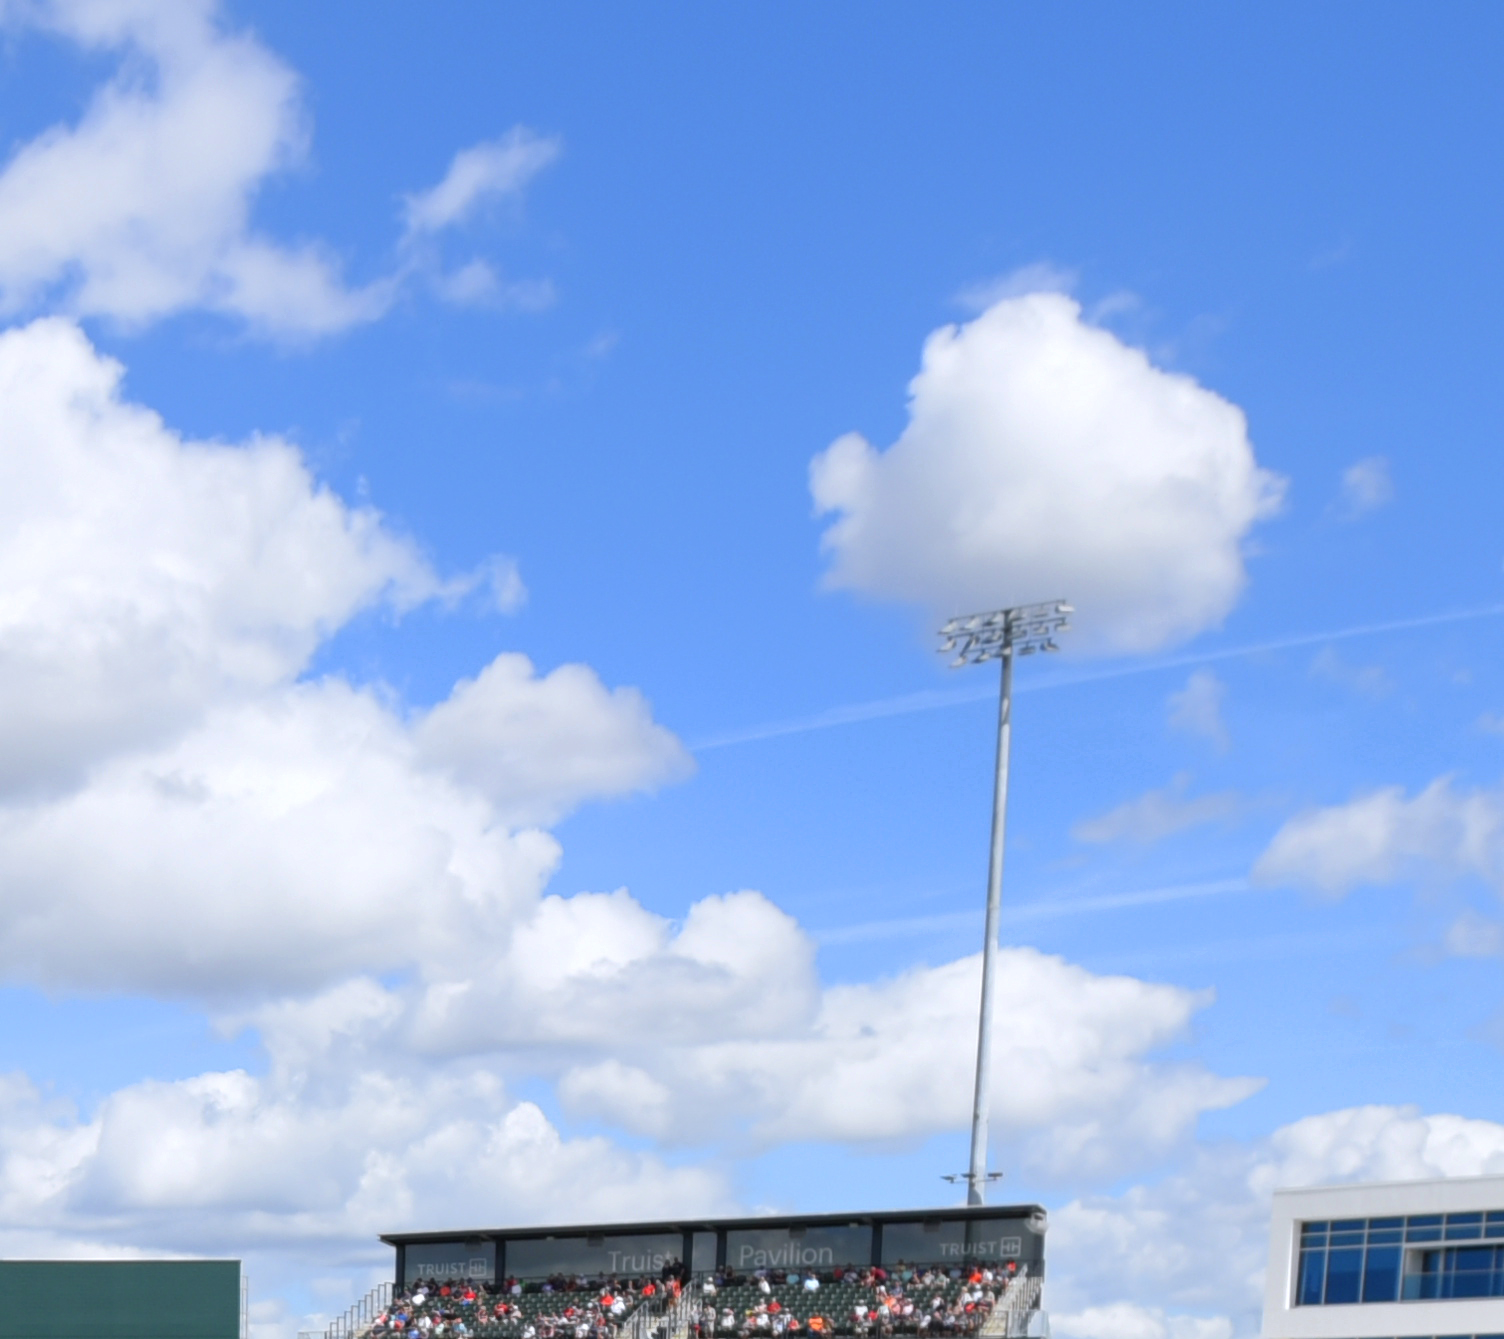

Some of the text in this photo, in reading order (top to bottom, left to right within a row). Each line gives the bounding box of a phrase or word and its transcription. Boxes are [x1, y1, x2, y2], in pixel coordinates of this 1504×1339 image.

[940, 1241, 998, 1257] TRUIST
[607, 1244, 834, 1273] Truist Pavilion
[417, 1262, 466, 1276] TRUIST
